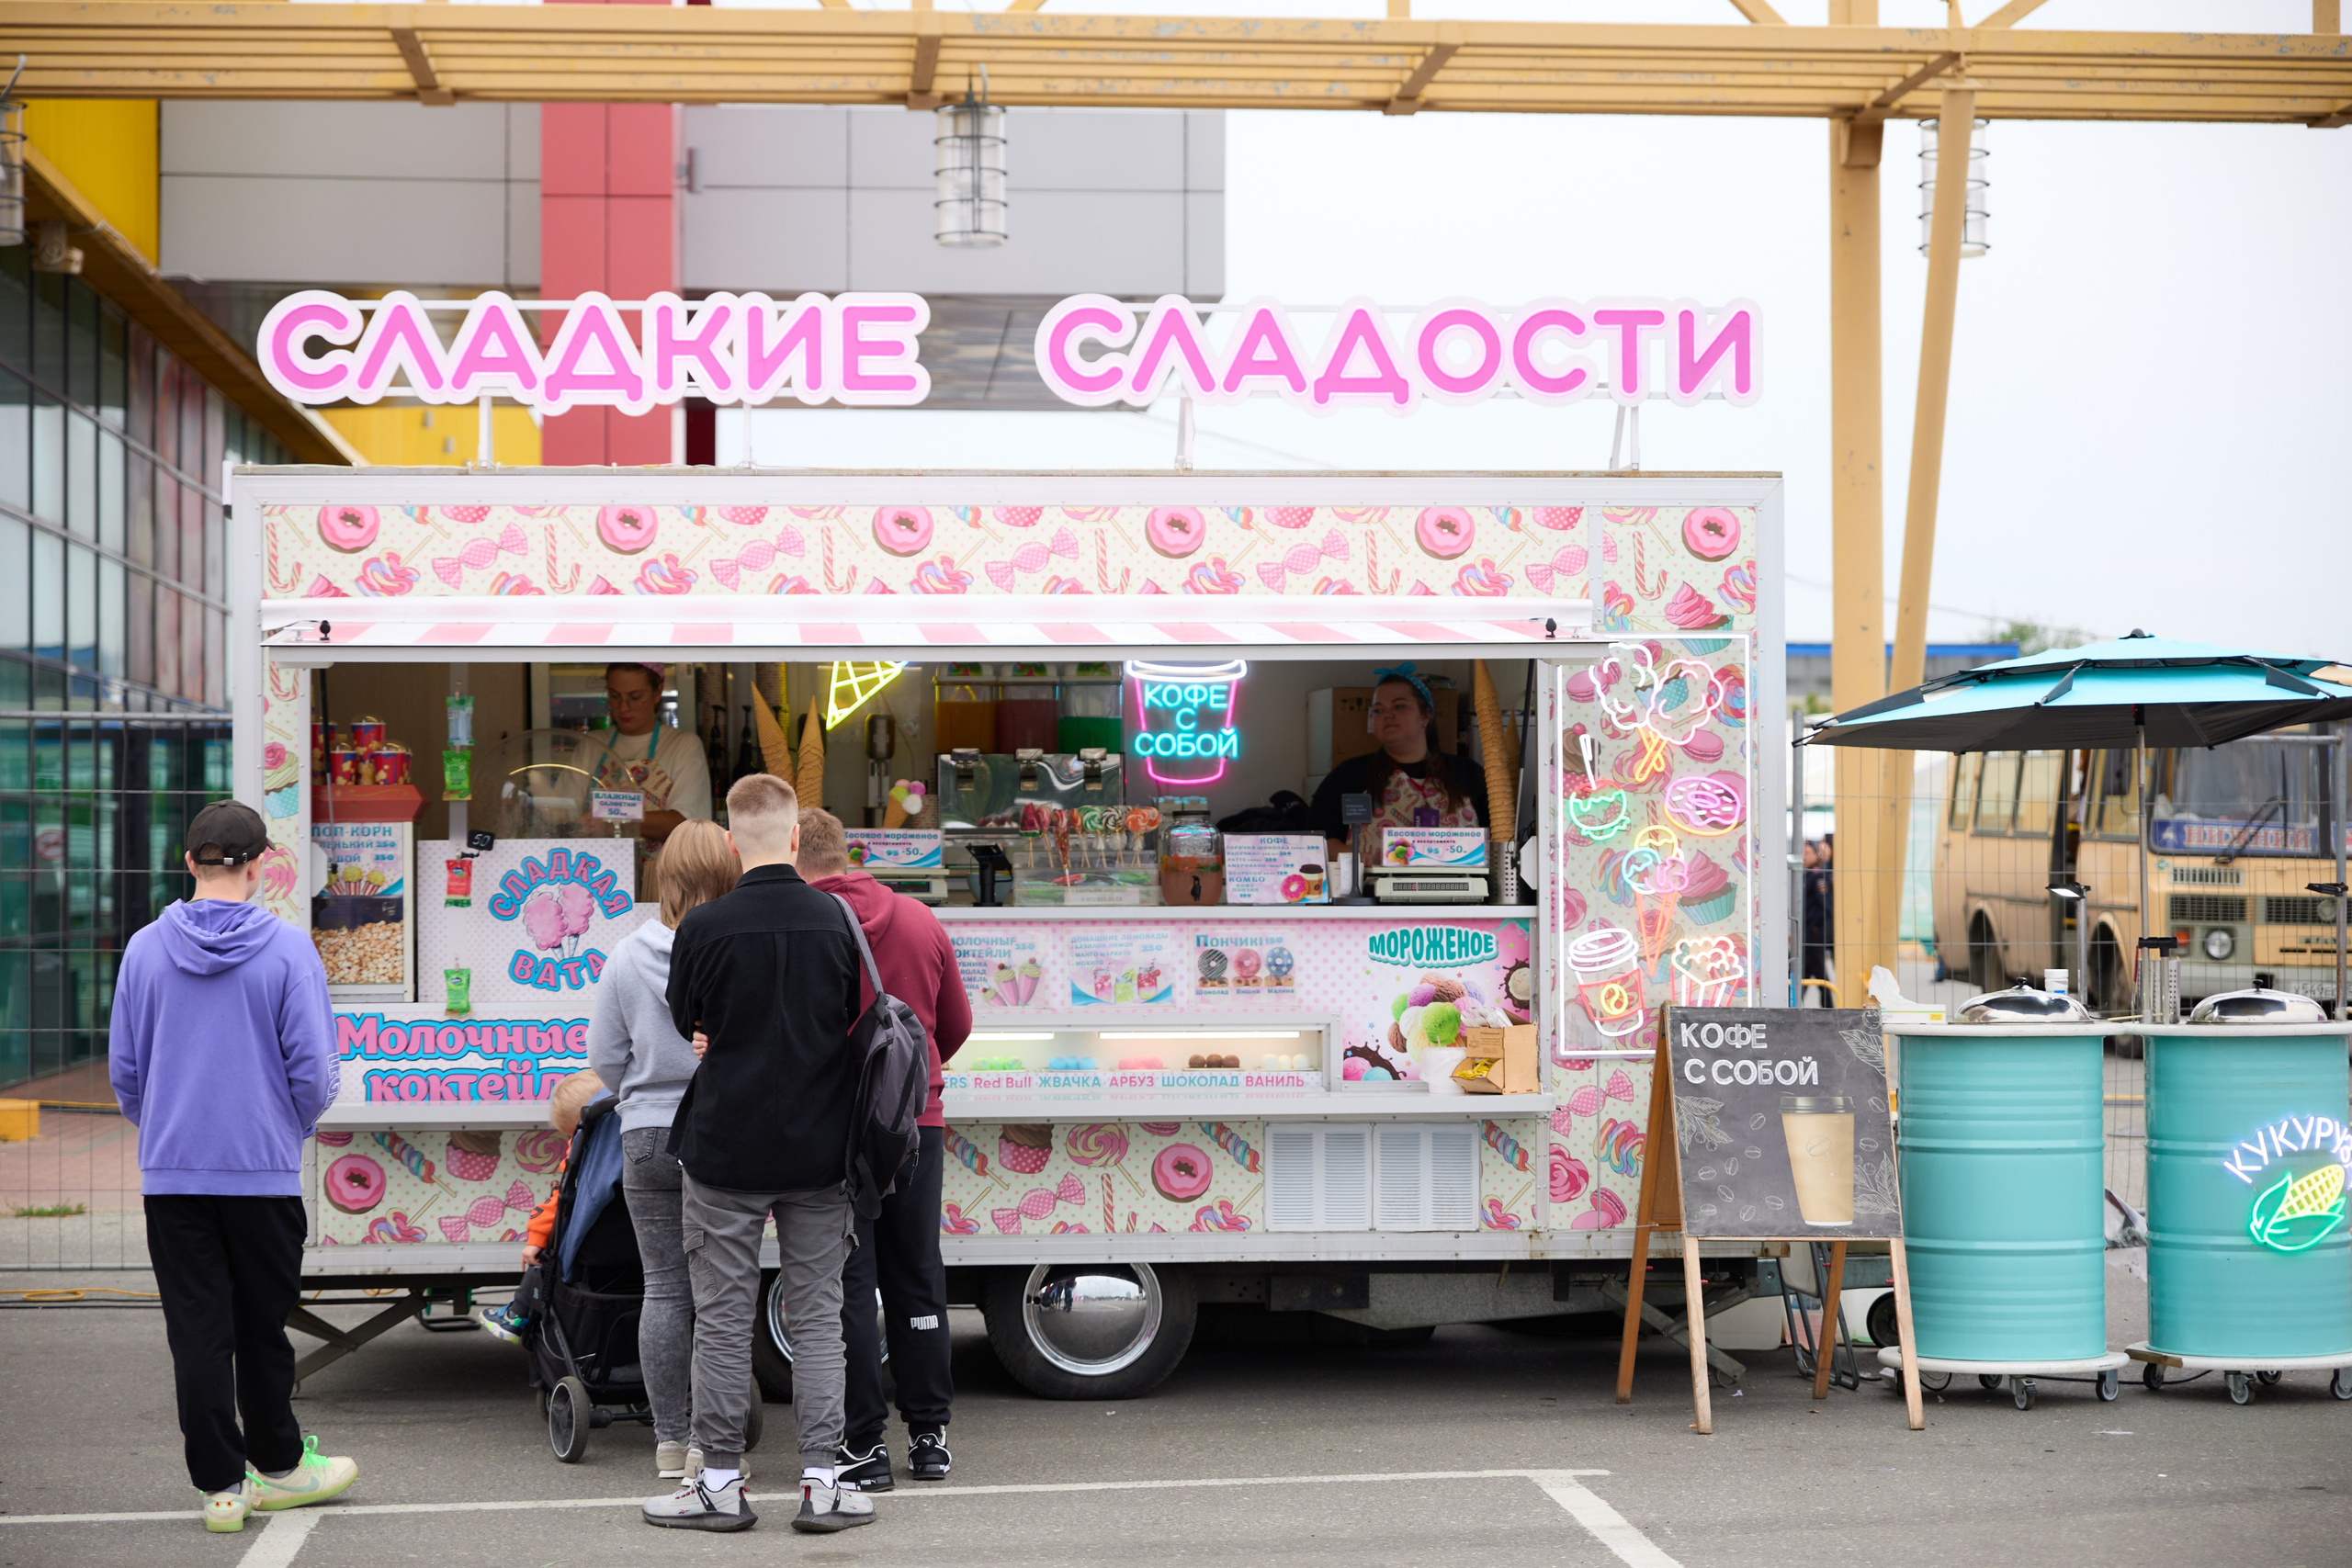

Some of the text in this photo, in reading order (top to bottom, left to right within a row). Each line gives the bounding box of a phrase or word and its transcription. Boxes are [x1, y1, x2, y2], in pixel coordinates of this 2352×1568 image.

[273, 302, 1752, 405] СЛАДКИЕ СЛАДОСТИ
[1144, 682, 1229, 709] КОФЕ
[1175, 707, 1197, 732] С
[1134, 728, 1238, 760] СОБОЙ
[594, 792, 642, 801] ВЛАЖНЫЕ
[472, 833, 491, 847] 50
[884, 831, 938, 840] мороженое
[1429, 830, 1481, 839] мороженое
[320, 839, 374, 849] ЛЕНЬКИЙ
[492, 851, 630, 919] СЛАДКАЯ
[955, 946, 1012, 958] ОКТЕЙЛИ
[1368, 926, 1496, 963] МОРОЖЕНОЕ
[511, 951, 608, 989] ВАТА
[334, 1014, 590, 1057] Молочные
[1679, 1022, 1769, 1050] КОФЕ
[1683, 1055, 1820, 1086] С СОБОЙ
[368, 1058, 575, 1101] коктейл
[973, 1076, 1001, 1089] Red
[1005, 1076, 1032, 1089] Bull
[1038, 1076, 1102, 1089] ЖВАЧКА
[1108, 1075, 1155, 1088] АРБУЗ
[1161, 1075, 1240, 1089] ШОКОЛАД
[1245, 1075, 1305, 1089] ВАНИЛЬ
[910, 1314, 939, 1330] PUMA
